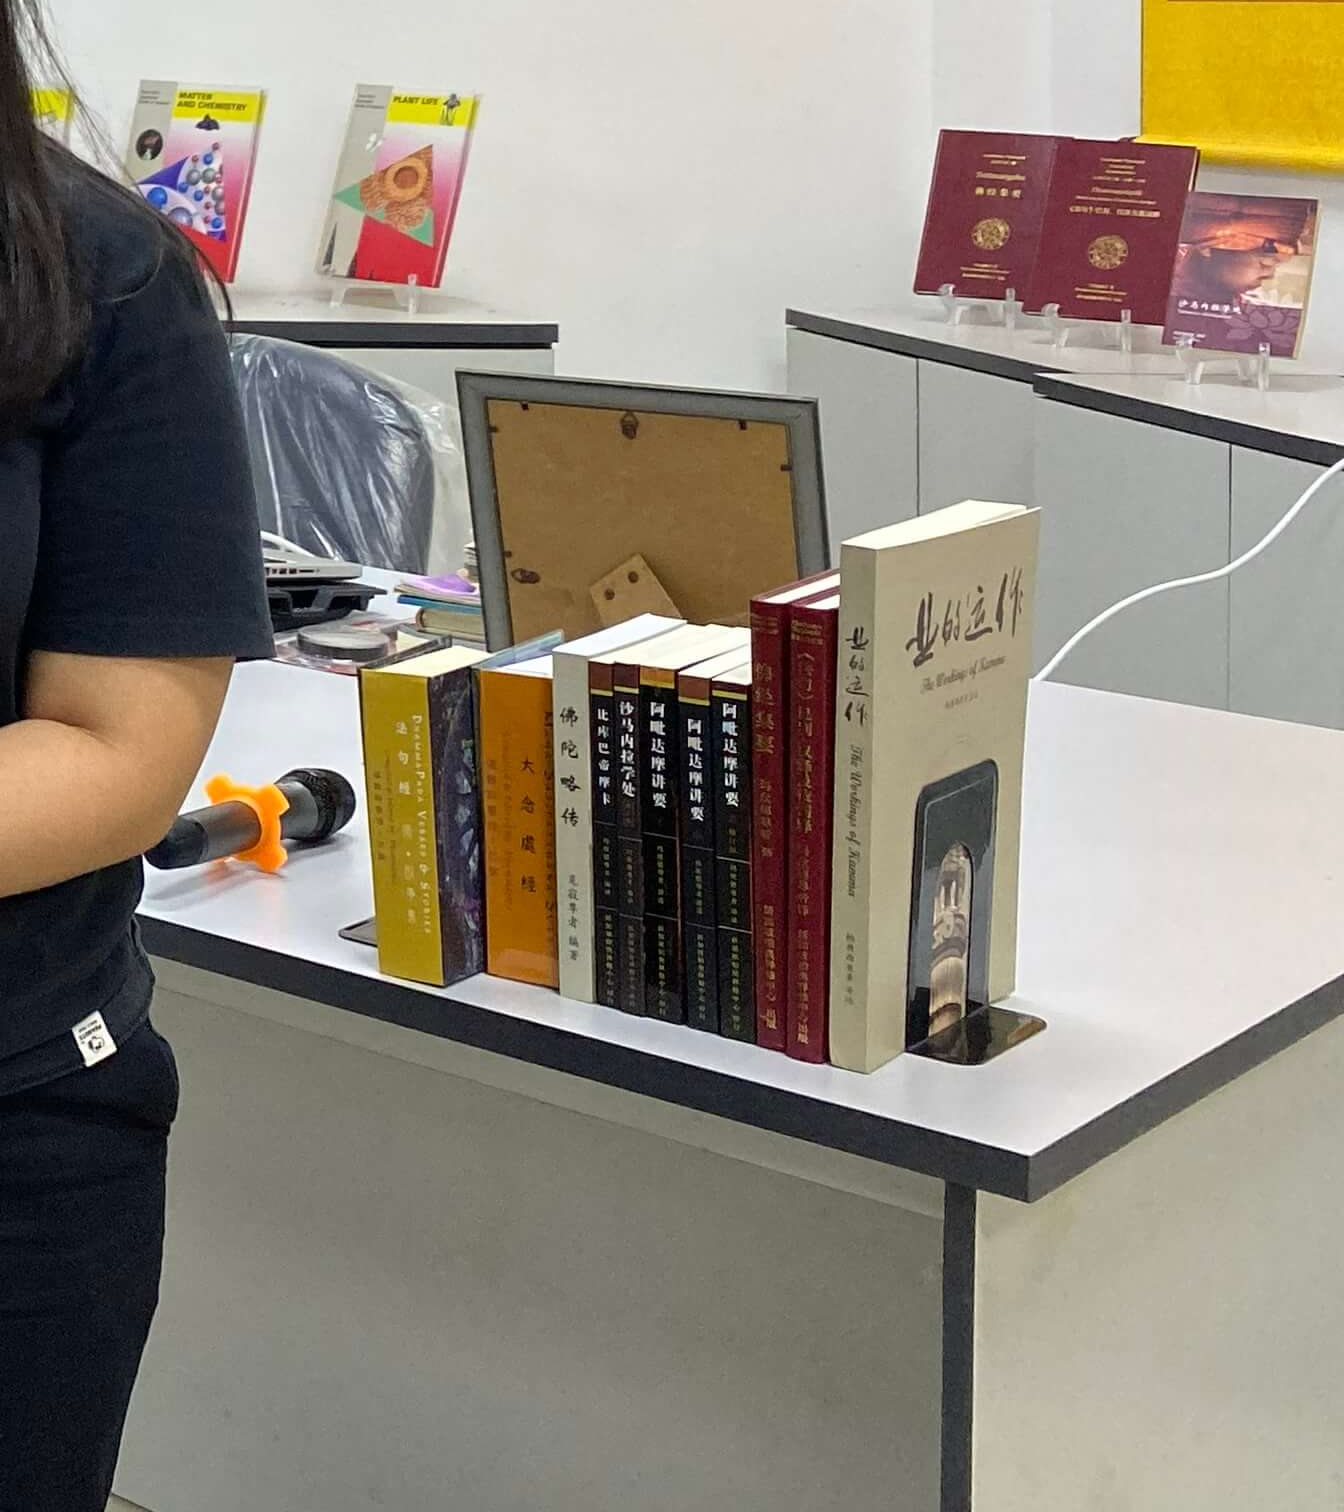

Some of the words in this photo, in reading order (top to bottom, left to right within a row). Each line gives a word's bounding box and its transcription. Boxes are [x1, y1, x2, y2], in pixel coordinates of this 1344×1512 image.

[178, 91, 213, 100] MATTER
[392, 95, 420, 104] PLANT
[421, 97, 440, 105] LIFE
[176, 100, 196, 108] AND
[197, 101, 247, 111] CHEMISTRY
